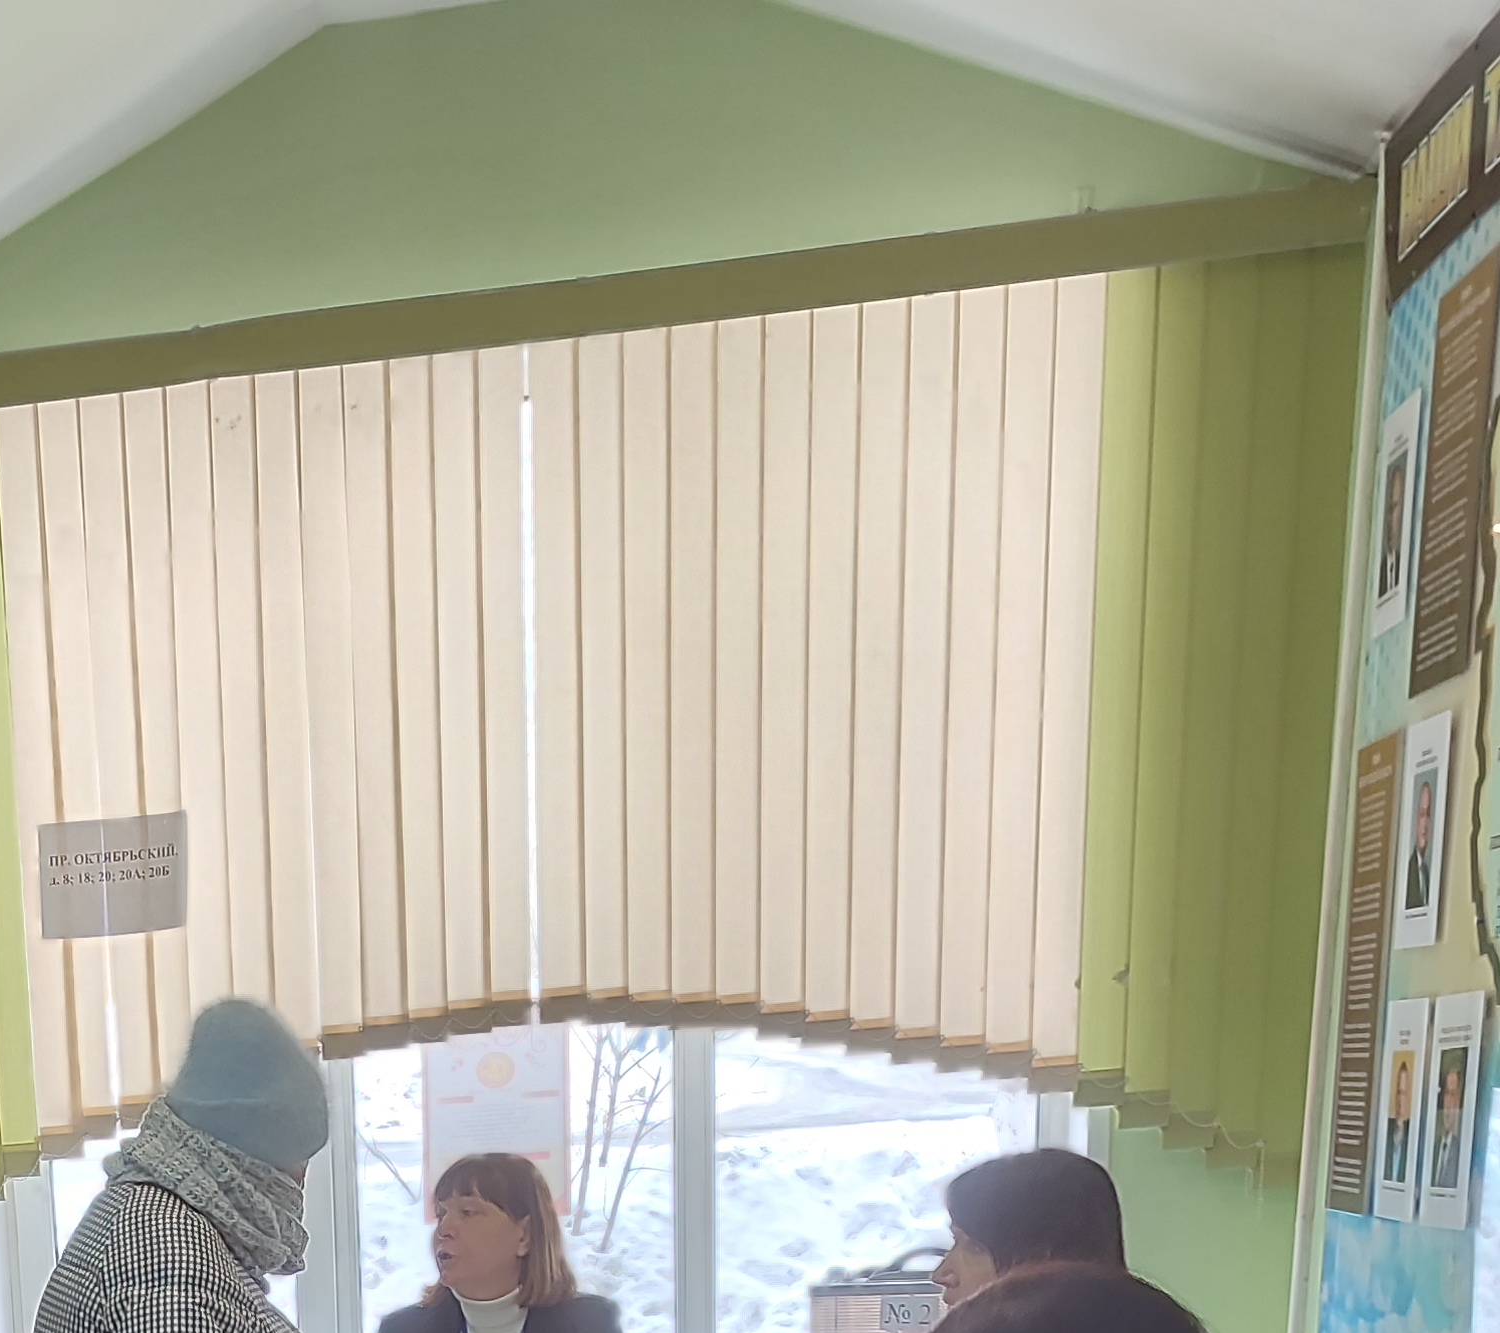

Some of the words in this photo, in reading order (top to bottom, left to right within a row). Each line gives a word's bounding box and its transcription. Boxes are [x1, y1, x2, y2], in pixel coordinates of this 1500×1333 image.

[49, 854, 71, 867] ПР.
[49, 877, 60, 887] д.
[62, 873, 74, 886] 8;
[79, 872, 95, 884] 18;
[98, 870, 116, 883] 20;
[119, 867, 146, 881] 20А;
[148, 865, 170, 878] 20Б
[883, 1302, 911, 1325] №
[918, 1303, 932, 1325] 2
